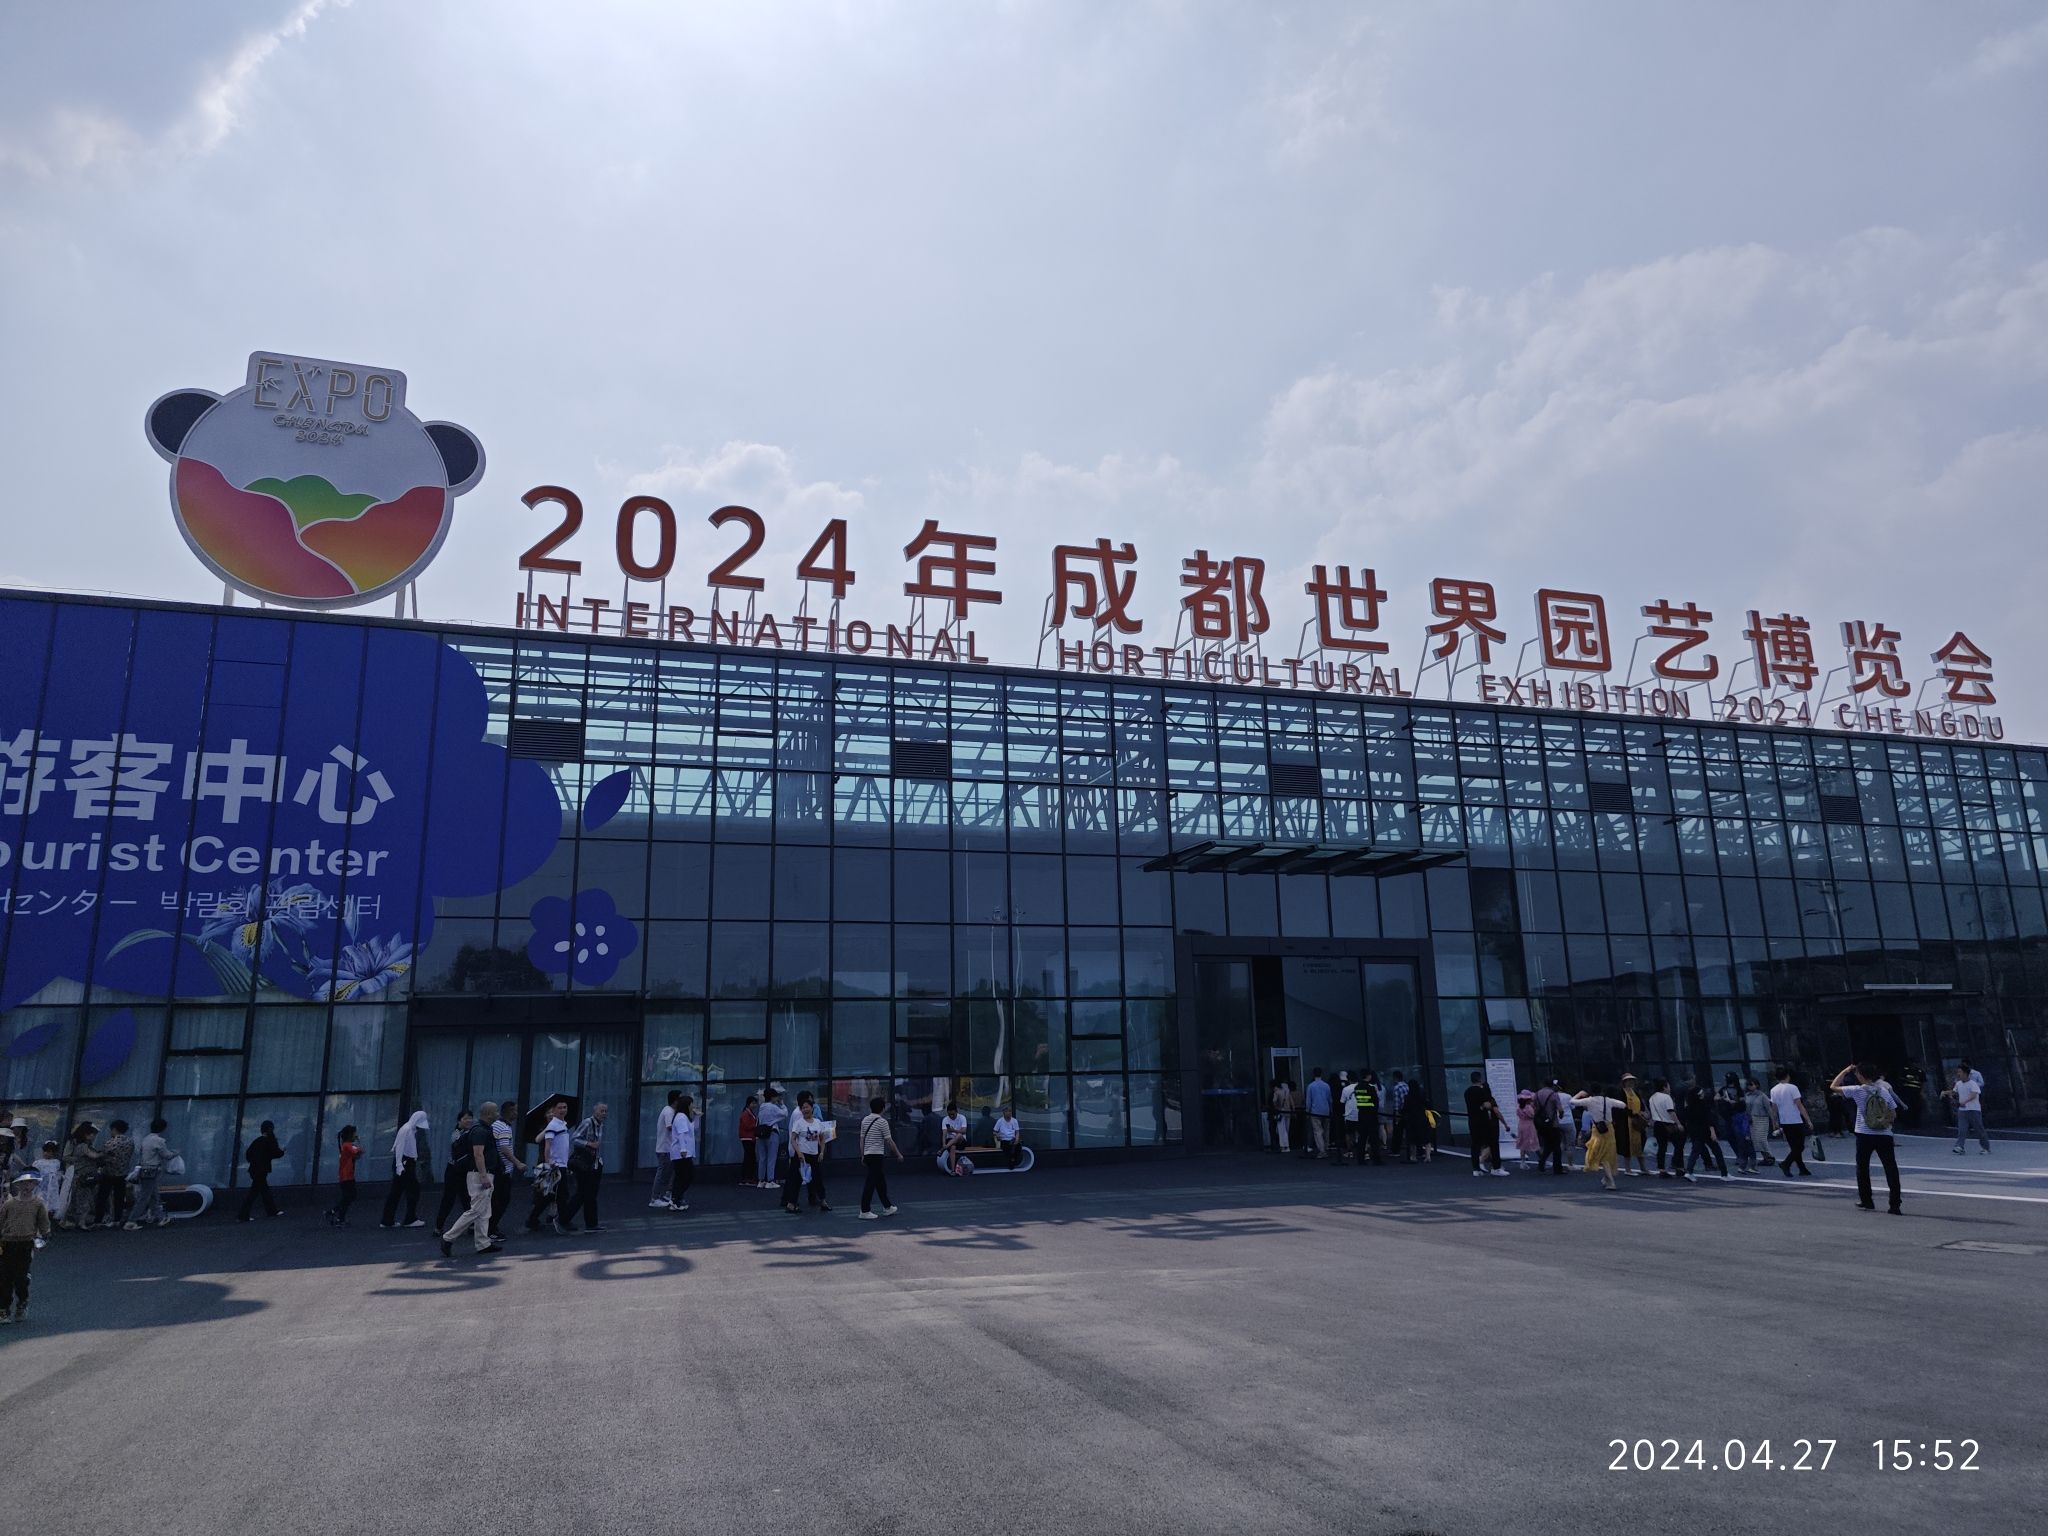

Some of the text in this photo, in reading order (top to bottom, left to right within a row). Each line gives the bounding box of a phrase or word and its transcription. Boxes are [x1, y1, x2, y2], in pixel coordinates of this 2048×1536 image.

[253, 358, 393, 422] EXPO
[272, 414, 369, 436] CHENGDU
[295, 430, 344, 446] 2024
[518, 484, 1998, 706] 2024年成都世界园艺博览会
[515, 591, 2005, 742] INTERNATIONAL HORTICULTURAL EXHIBITION 2024 CHENGDU
[179, 834, 390, 878] Center
